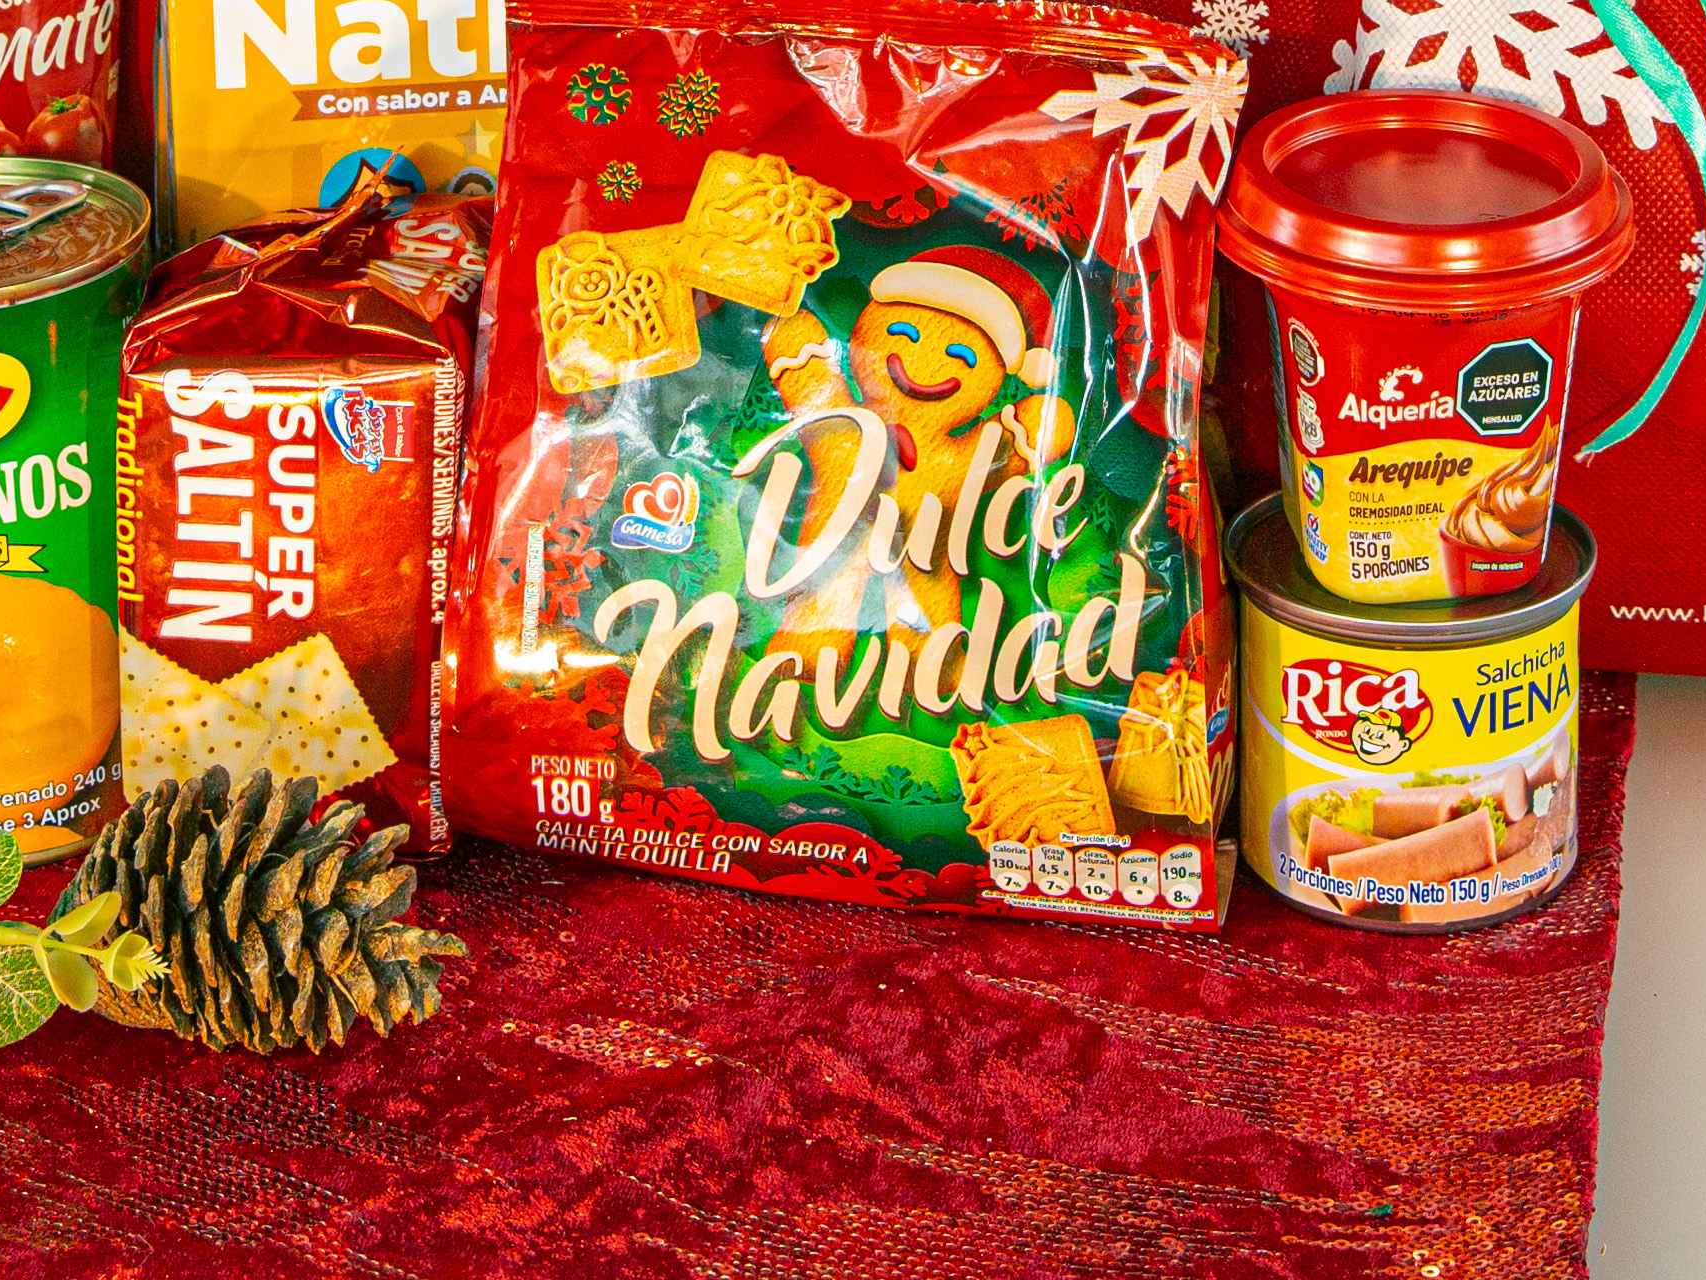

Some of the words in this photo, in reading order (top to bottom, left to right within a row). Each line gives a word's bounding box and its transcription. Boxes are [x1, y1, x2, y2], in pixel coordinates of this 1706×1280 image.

[318, 94, 369, 114] Con
[376, 89, 449, 111] sabor
[457, 91, 471, 106] a
[1468, 384, 1540, 403] AZÚCARES
[1474, 374, 1519, 388] EXCESO
[1523, 371, 1538, 384] EN
[342, 391, 368, 460] RICAS
[1338, 390, 1454, 430] Alquería
[1482, 414, 1522, 424] MINSALUD
[1349, 452, 1473, 488] Arequipe
[118, 395, 143, 603] Tradicional
[268, 404, 315, 619] SUPER
[732, 406, 1088, 600] Dulce
[1349, 492, 1369, 503] CON
[1372, 492, 1385, 503] LA
[1349, 505, 1412, 519] CREMOSIDAD
[1415, 503, 1445, 514] IDEAL
[621, 519, 683, 546] Gamesa
[1349, 532, 1370, 541] CONT.
[1349, 542, 1377, 558] 150
[1382, 544, 1390, 560] g
[1351, 563, 1361, 579] 5
[1364, 557, 1429, 579] PORCIONES
[594, 553, 1146, 764] Navidad
[1477, 641, 1564, 687] Salchicha
[1282, 661, 1424, 727] Rica
[1452, 663, 1570, 737] VIENA
[73, 766, 106, 791] 240
[111, 762, 122, 781] g
[531, 755, 570, 776] PESO
[574, 758, 616, 780] NETO
[23, 812, 34, 829] 3
[40, 796, 101, 826] Aprox
[531, 778, 591, 817] 180
[599, 800, 614, 823] g
[535, 819, 625, 843] GALLETA
[633, 829, 704, 851] DULCE
[712, 835, 760, 853] CON
[767, 838, 846, 861] SABOR
[853, 847, 868, 864] A
[536, 832, 731, 874] MANTEQUILLA
[1280, 854, 1287, 874] 2
[1290, 860, 1352, 897] Porciones
[1367, 880, 1404, 903] Peso
[1410, 883, 1443, 903] Neto
[1450, 879, 1476, 901] 150
[1481, 881, 1489, 902] g
[1502, 880, 1520, 893] Peso
